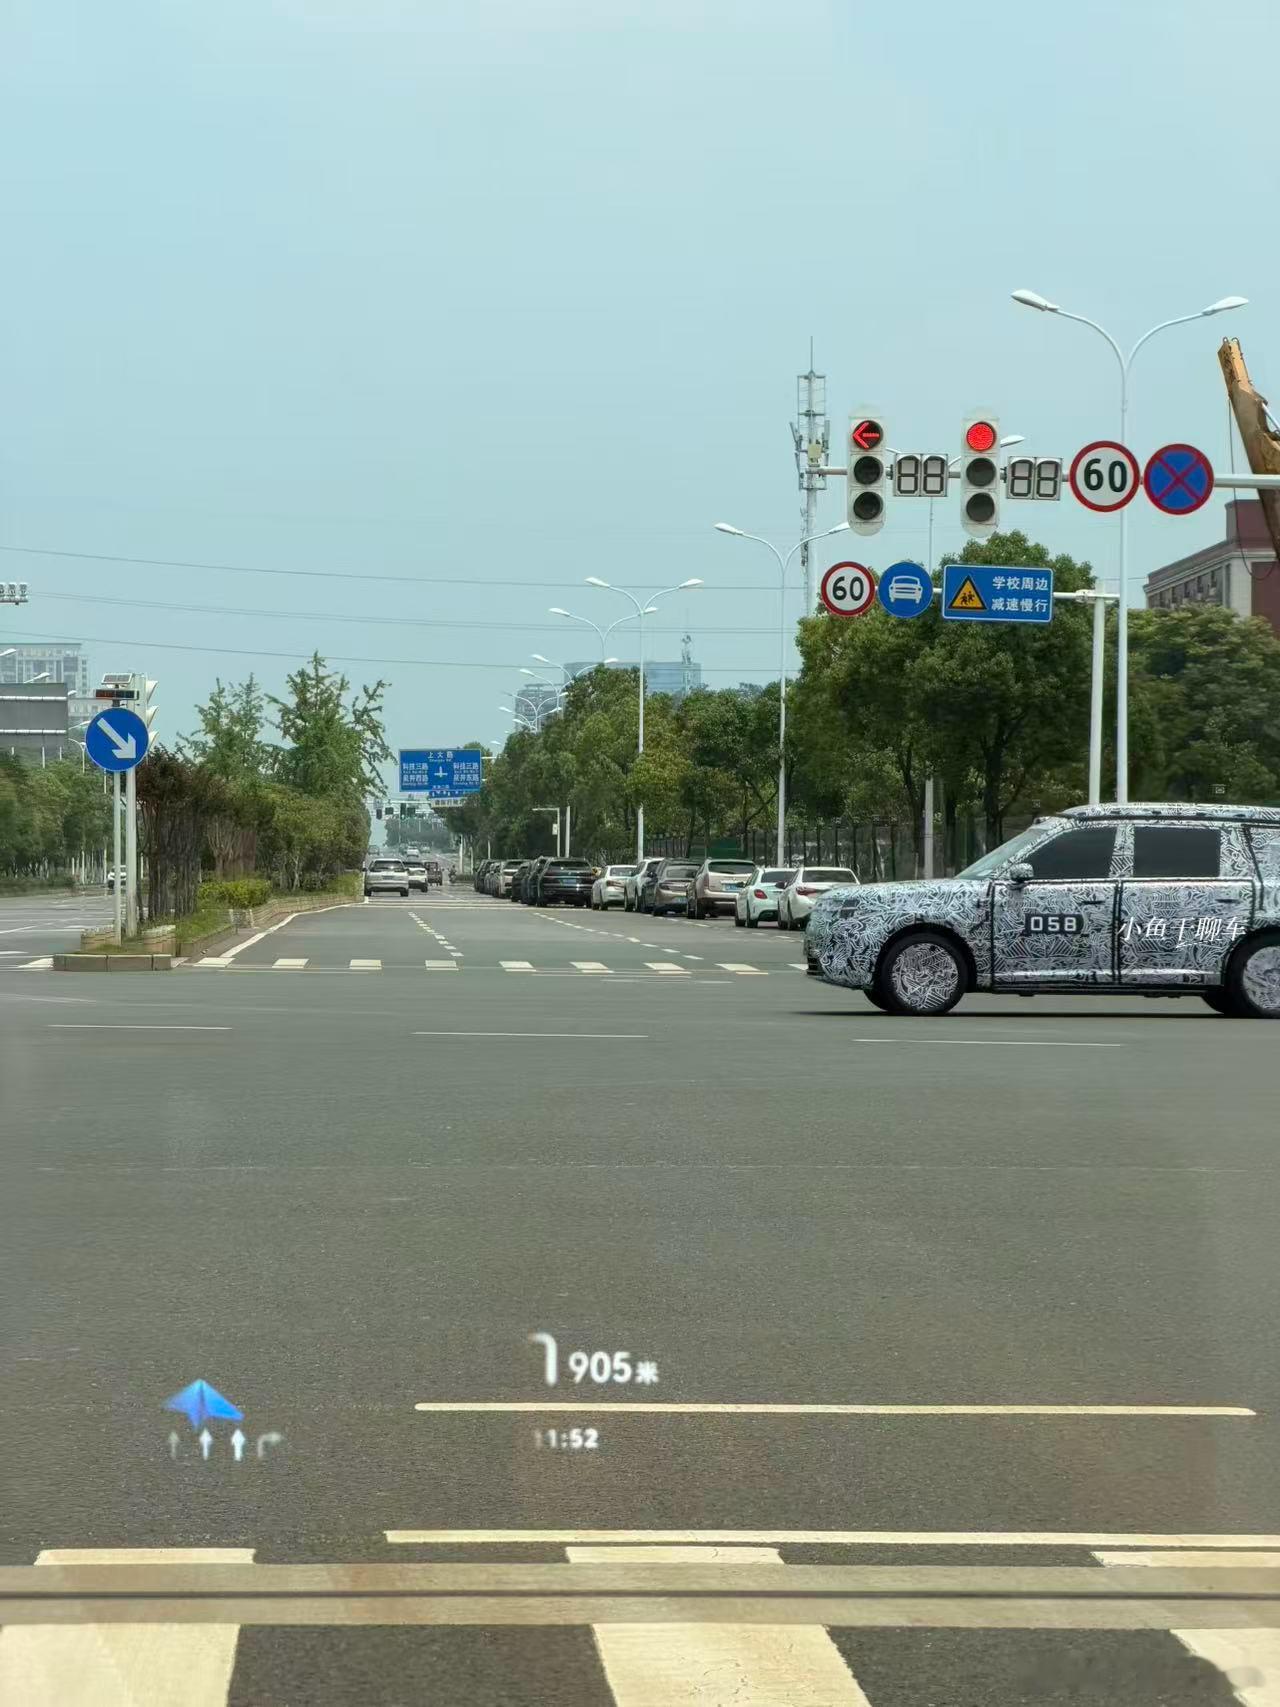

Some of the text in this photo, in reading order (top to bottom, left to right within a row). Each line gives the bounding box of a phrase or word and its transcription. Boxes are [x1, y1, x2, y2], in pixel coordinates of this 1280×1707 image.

[1083, 459, 1127, 493] 60
[832, 576, 865, 602] 60
[992, 575, 1049, 592] 学校周边
[991, 597, 1049, 613] 减速慢行
[1030, 916, 1077, 931] 058
[533, 1428, 600, 1450] 11:52
